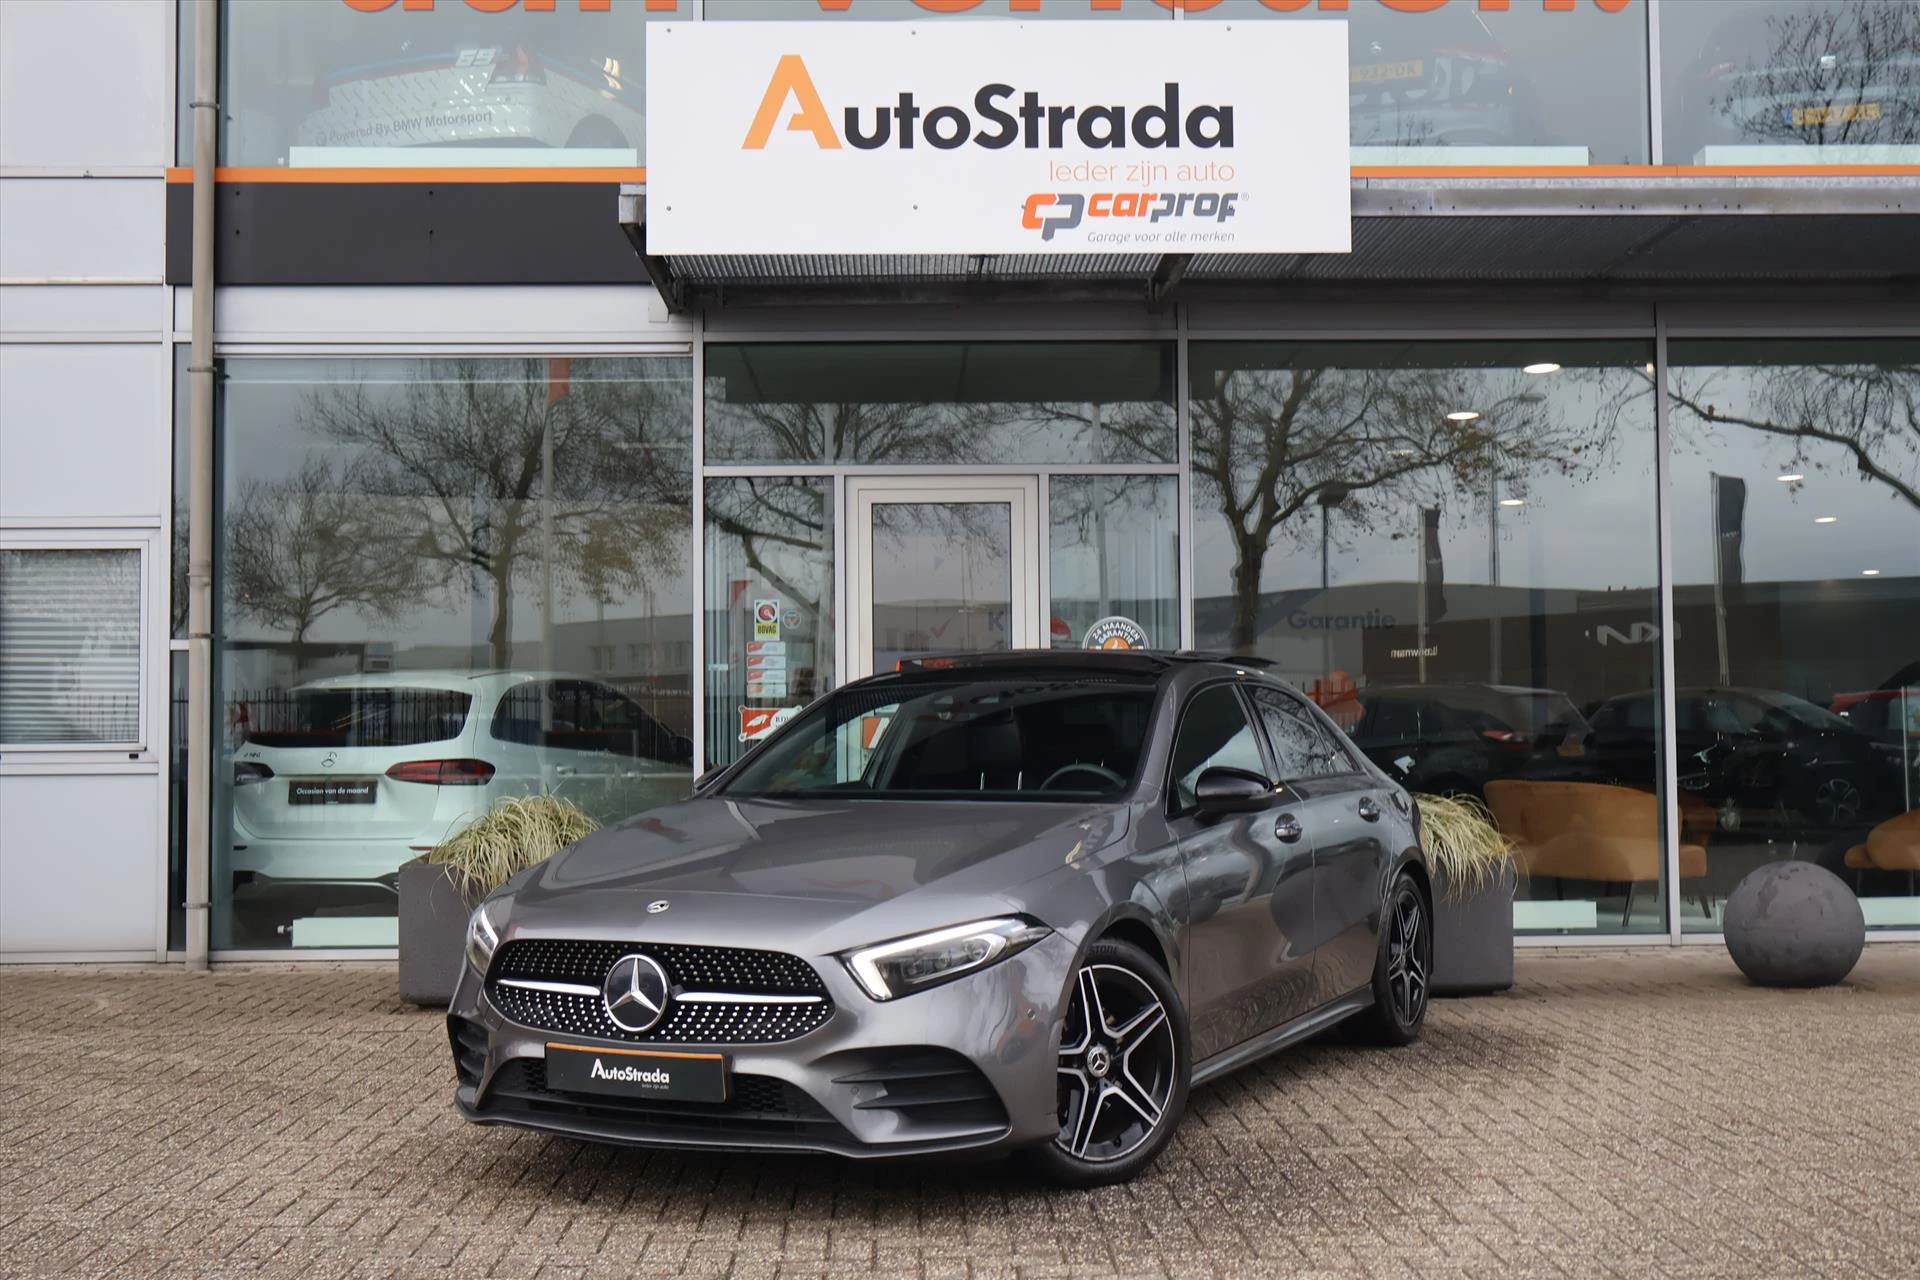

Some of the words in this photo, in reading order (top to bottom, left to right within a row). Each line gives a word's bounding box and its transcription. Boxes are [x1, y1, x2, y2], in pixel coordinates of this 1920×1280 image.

[743, 55, 1235, 151] AutoStrada
[329, 125, 372, 142] Powered
[375, 122, 390, 136] By
[393, 117, 422, 131] BMW
[425, 111, 492, 127] Motorsport
[1049, 160, 1118, 182] Ieder
[1126, 160, 1168, 187] zijn
[1176, 161, 1235, 182] auto
[1088, 231, 1131, 243] Garage
[1134, 233, 1162, 242] voor
[1165, 231, 1186, 242] alle
[1190, 231, 1235, 242] merken
[1286, 608, 1397, 630] Garantie
[1092, 628, 1102, 641] 24
[1102, 622, 1140, 641] MAANDEN
[1098, 630, 1135, 645] GARANTIE
[296, 787, 323, 795] Occasion
[338, 787, 346, 795] de
[347, 787, 369, 795] maand
[591, 1058, 670, 1084] AutoStrada
